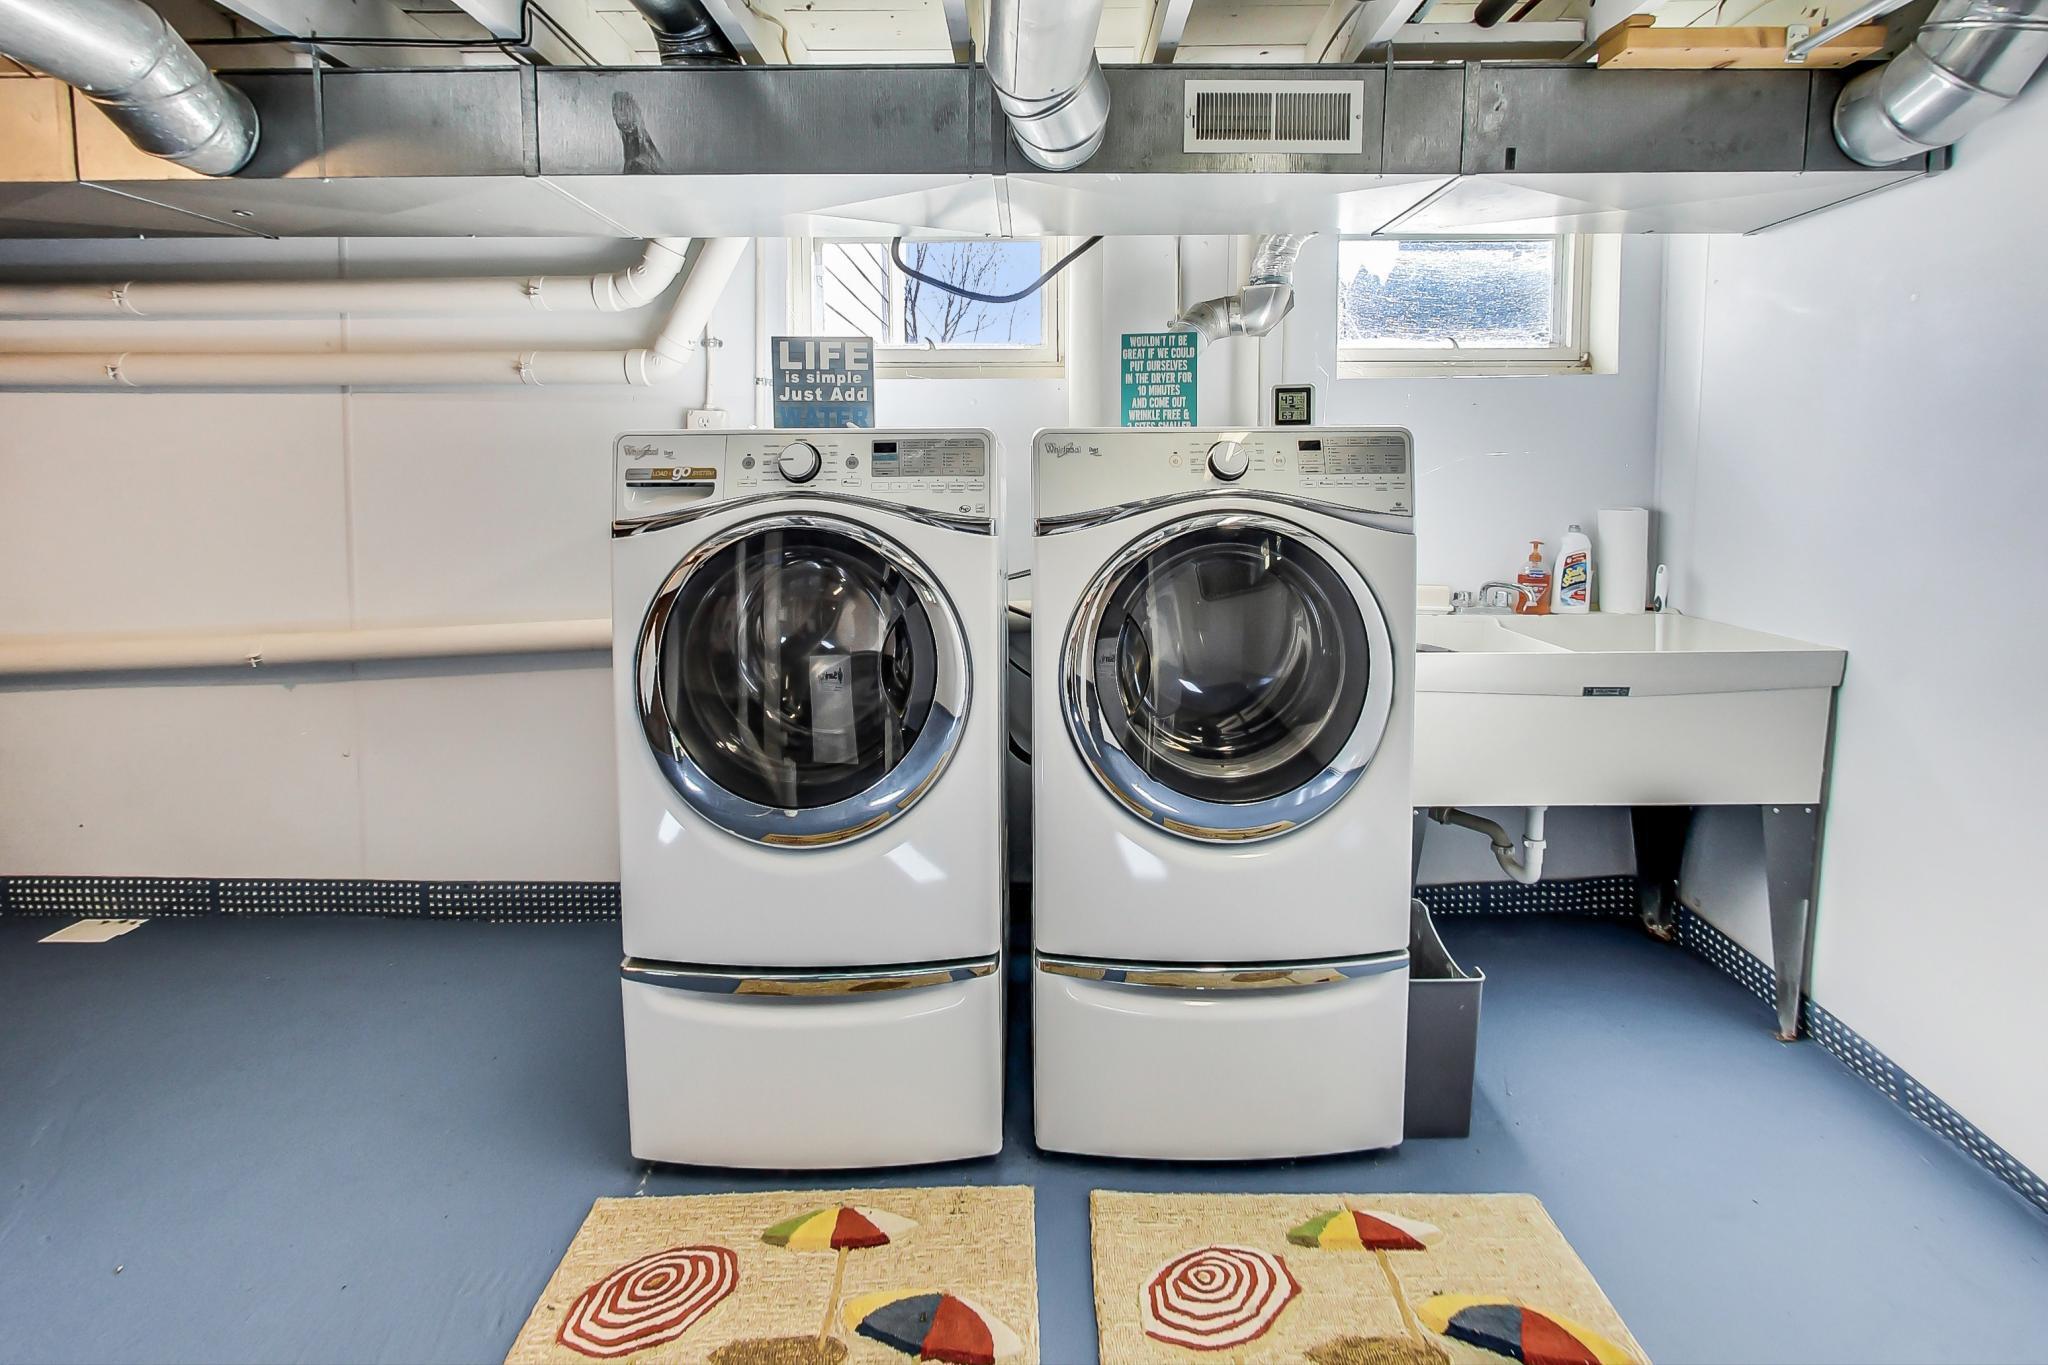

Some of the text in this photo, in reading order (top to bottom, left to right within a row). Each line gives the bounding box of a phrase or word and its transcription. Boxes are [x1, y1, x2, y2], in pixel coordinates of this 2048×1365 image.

[1130, 335, 1188, 347] WOULDN'T IT BE
[780, 341, 868, 370] LIFE
[1122, 347, 1194, 359] GREAT IF WE COULD
[1130, 360, 1188, 372] PUT OURSELVES
[785, 371, 862, 386] is simple
[1126, 372, 1192, 384] IN THE DRYER FOR
[780, 386, 868, 401] Just Add
[1138, 384, 1180, 396] 10 MINUTES
[1132, 397, 1186, 408] AND COME OUT
[780, 405, 869, 426] WATER
[1129, 409, 1160, 420] WRINKLE
[1163, 409, 1181, 420] FREE
[672, 467, 691, 480] go
